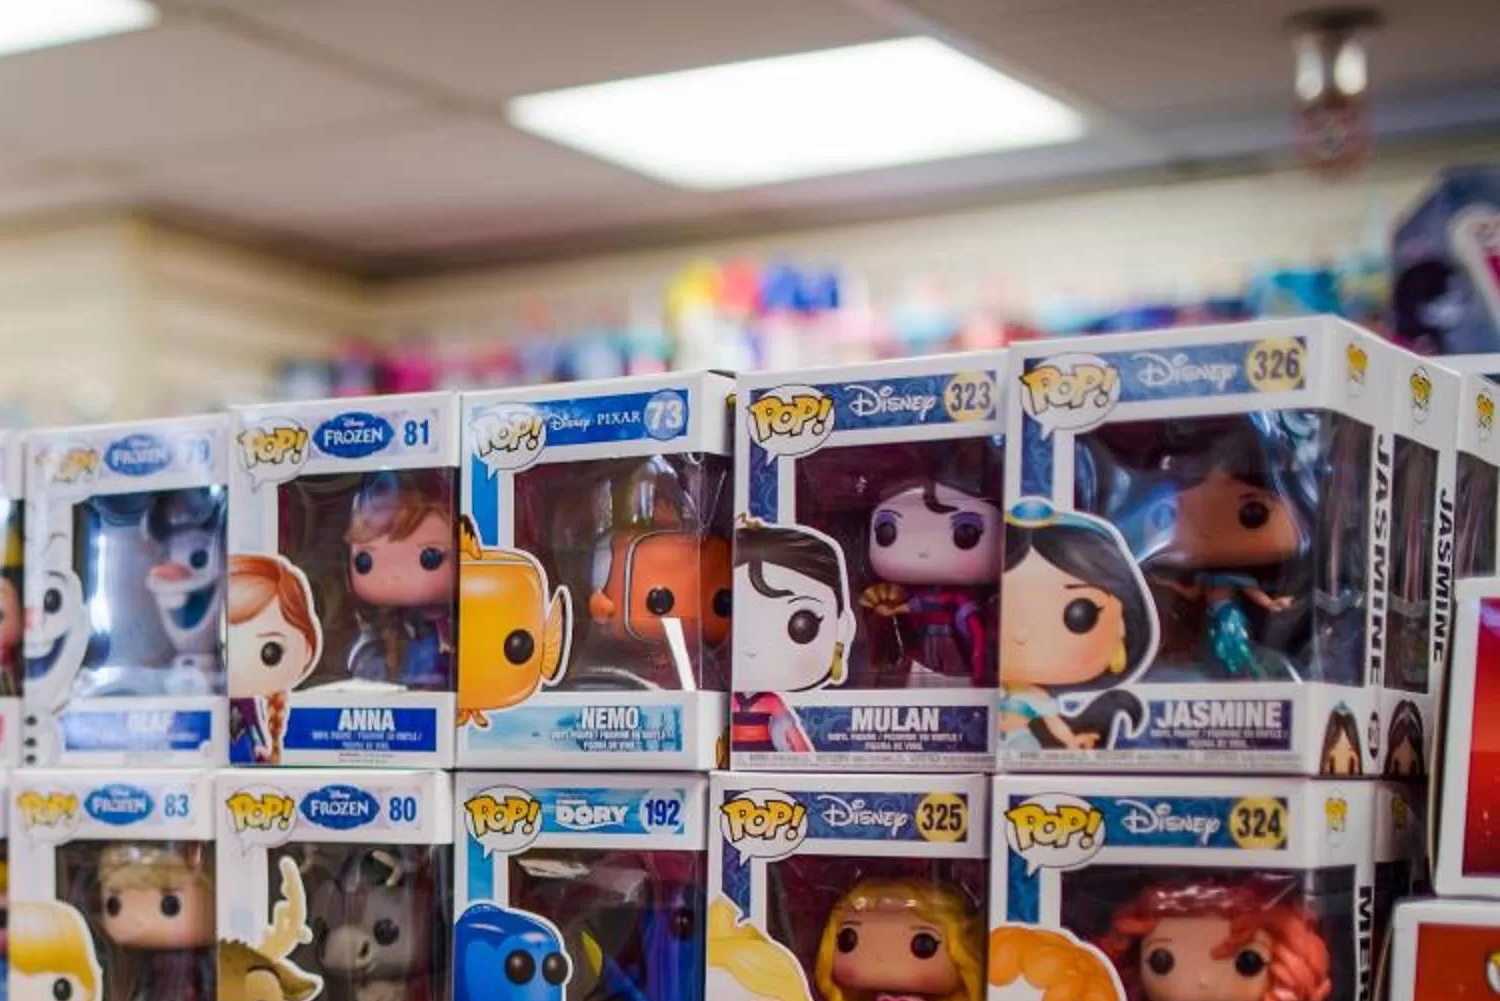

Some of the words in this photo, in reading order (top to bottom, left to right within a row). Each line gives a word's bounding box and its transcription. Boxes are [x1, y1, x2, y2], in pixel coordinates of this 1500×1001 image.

[1132, 352, 1237, 390] Disney
[1254, 349, 1300, 381] 326
[844, 385, 936, 421] Disney
[951, 381, 991, 412] 323
[1020, 365, 1117, 415] POP!
[404, 420, 429, 446] 81
[597, 411, 640, 425] PIXAR
[650, 399, 683, 429] 73
[748, 395, 833, 441] POP!
[237, 427, 309, 468] POP!
[324, 428, 383, 447] FROZEN
[473, 414, 543, 456] POP!
[1367, 434, 1394, 687] JASMINE
[1431, 487, 1453, 664] JASMINE
[338, 707, 396, 731] ANNA
[581, 706, 639, 729] NEMO
[851, 707, 940, 731] MULAN
[1156, 700, 1282, 728] JASMINE
[164, 793, 189, 817] 83
[226, 792, 294, 832] POP!
[311, 799, 369, 816] FROZEN
[389, 796, 416, 821] 80
[464, 795, 541, 837] POP!
[555, 803, 629, 826] DORY
[645, 799, 680, 827] 192
[720, 797, 806, 842] POP!
[818, 793, 908, 838] Disney
[922, 803, 962, 831] 325
[1116, 800, 1220, 844] Disney
[1237, 807, 1281, 838] 324
[1004, 804, 1102, 850] POP!
